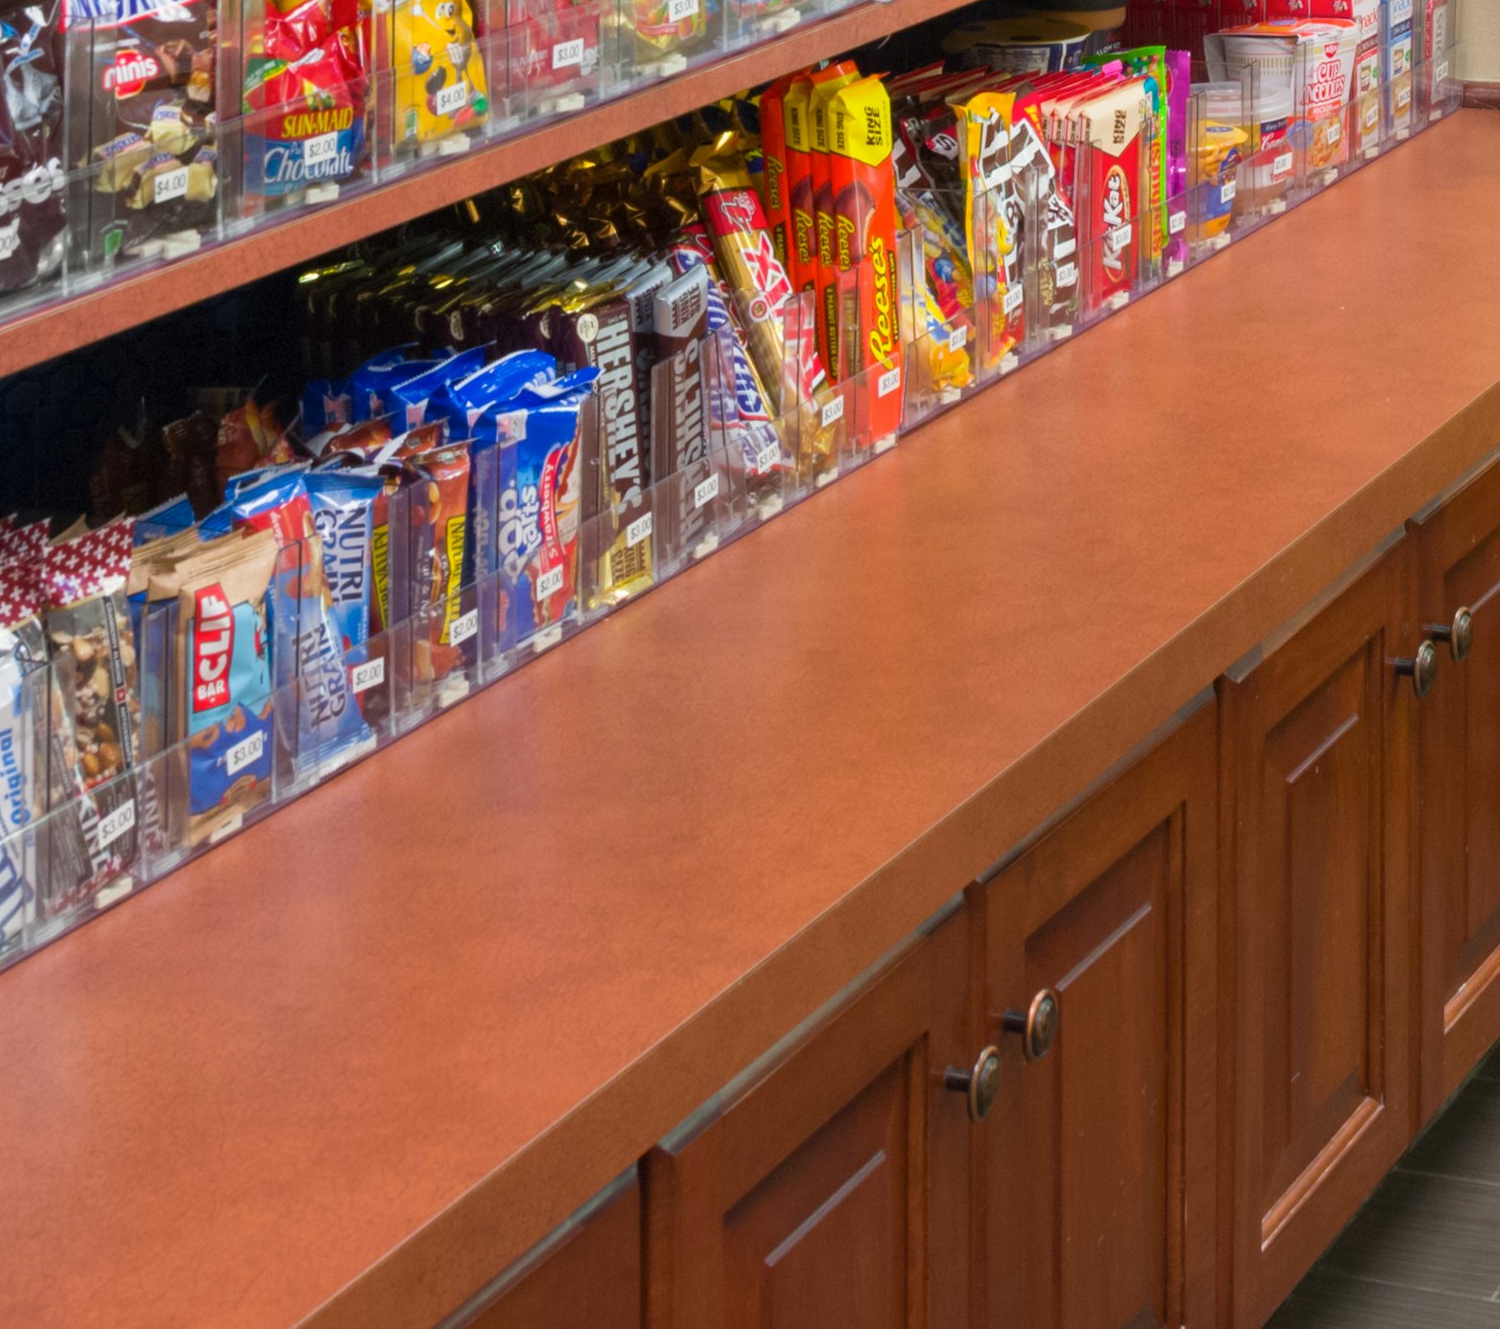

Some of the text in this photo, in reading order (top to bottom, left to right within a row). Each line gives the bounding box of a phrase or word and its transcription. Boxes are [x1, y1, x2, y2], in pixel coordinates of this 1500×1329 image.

[557, 46, 581, 63] $3.00
[104, 51, 159, 91] minis
[440, 89, 466, 107] $4.00
[282, 108, 353, 139] SUN-MAID
[309, 139, 336, 157] $2.00
[156, 173, 187, 194] $4.00
[882, 371, 899, 390] $3.00
[824, 401, 842, 420] $3.00
[758, 444, 778, 467] $3.00
[697, 479, 716, 499] $3.00
[541, 574, 562, 592] $2.00
[195, 585, 234, 677] CLIF
[453, 617, 478, 637] $2.00
[355, 664, 382, 684] $2.00
[196, 678, 226, 699] BAR
[233, 739, 262, 765] $3.00
[102, 807, 132, 838] $3.00
